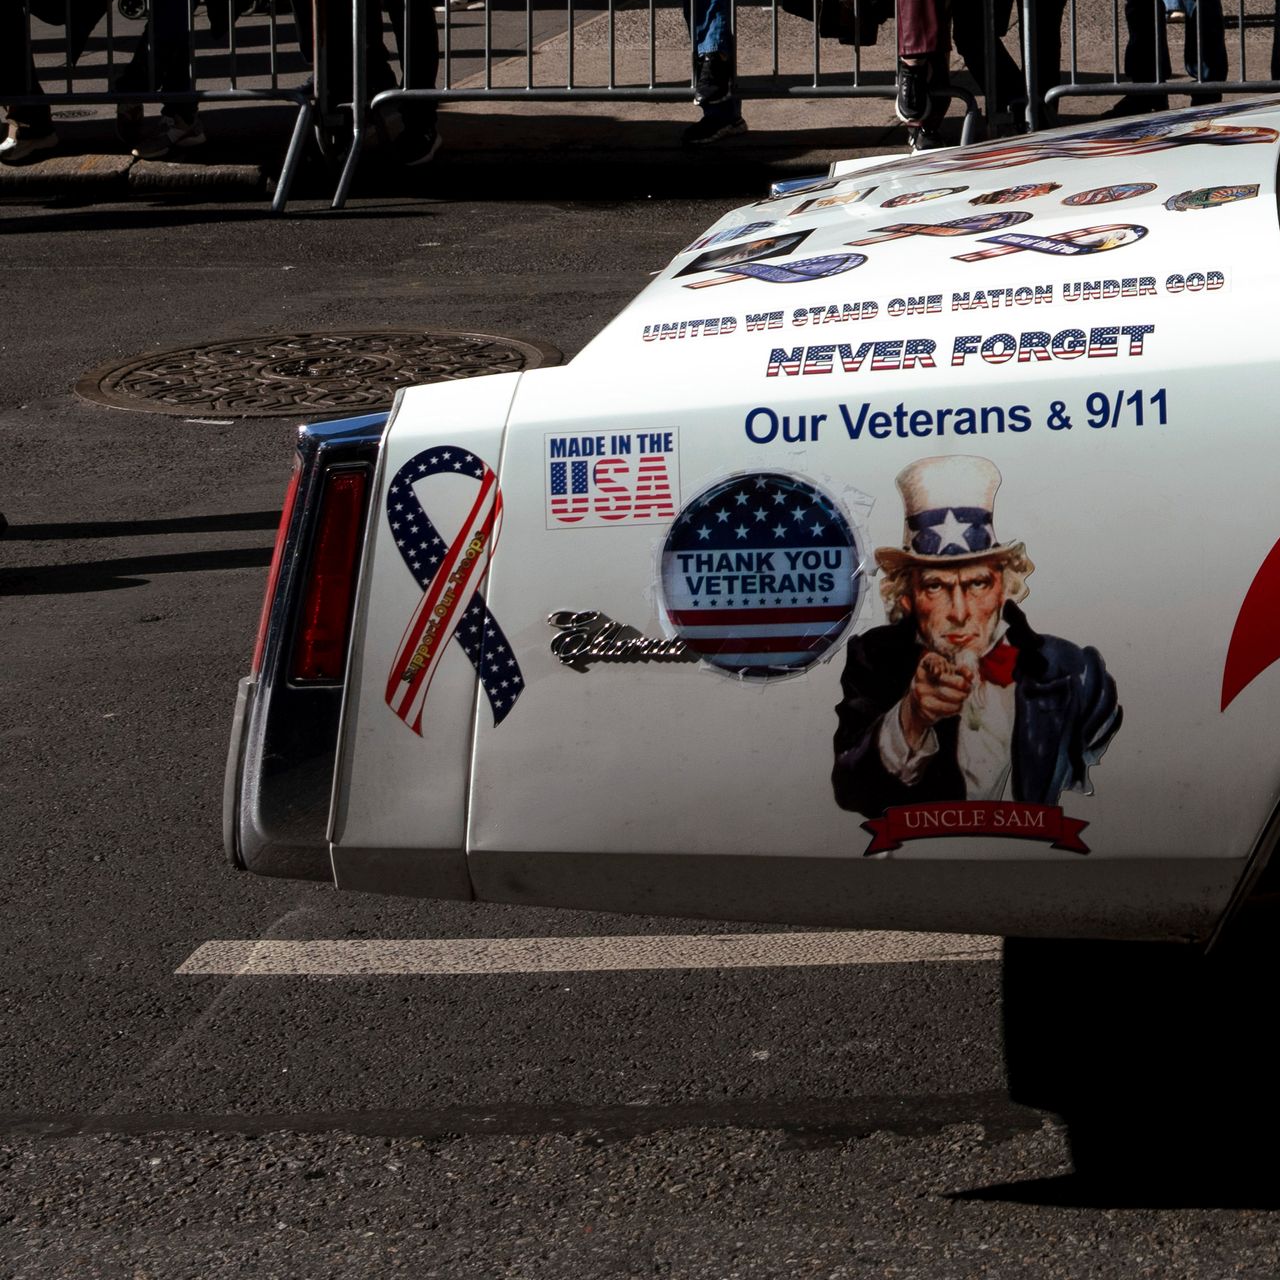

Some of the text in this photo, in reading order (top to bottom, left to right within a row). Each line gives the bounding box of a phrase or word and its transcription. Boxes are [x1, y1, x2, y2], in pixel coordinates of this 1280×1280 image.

[642, 270, 1225, 342] UNITED WE STAND ONE NATION UNDER GOD
[766, 324, 1155, 377] NEVER FORGET
[745, 388, 1169, 444] Our Veterans & 9/11
[550, 432, 674, 458] MADE IN THE
[550, 456, 675, 522] USA
[677, 550, 842, 573] THANK YOU
[685, 573, 835, 596] VETERANS
[402, 530, 485, 683] Support Our Troops
[904, 809, 1045, 829] UNCLE SAM
